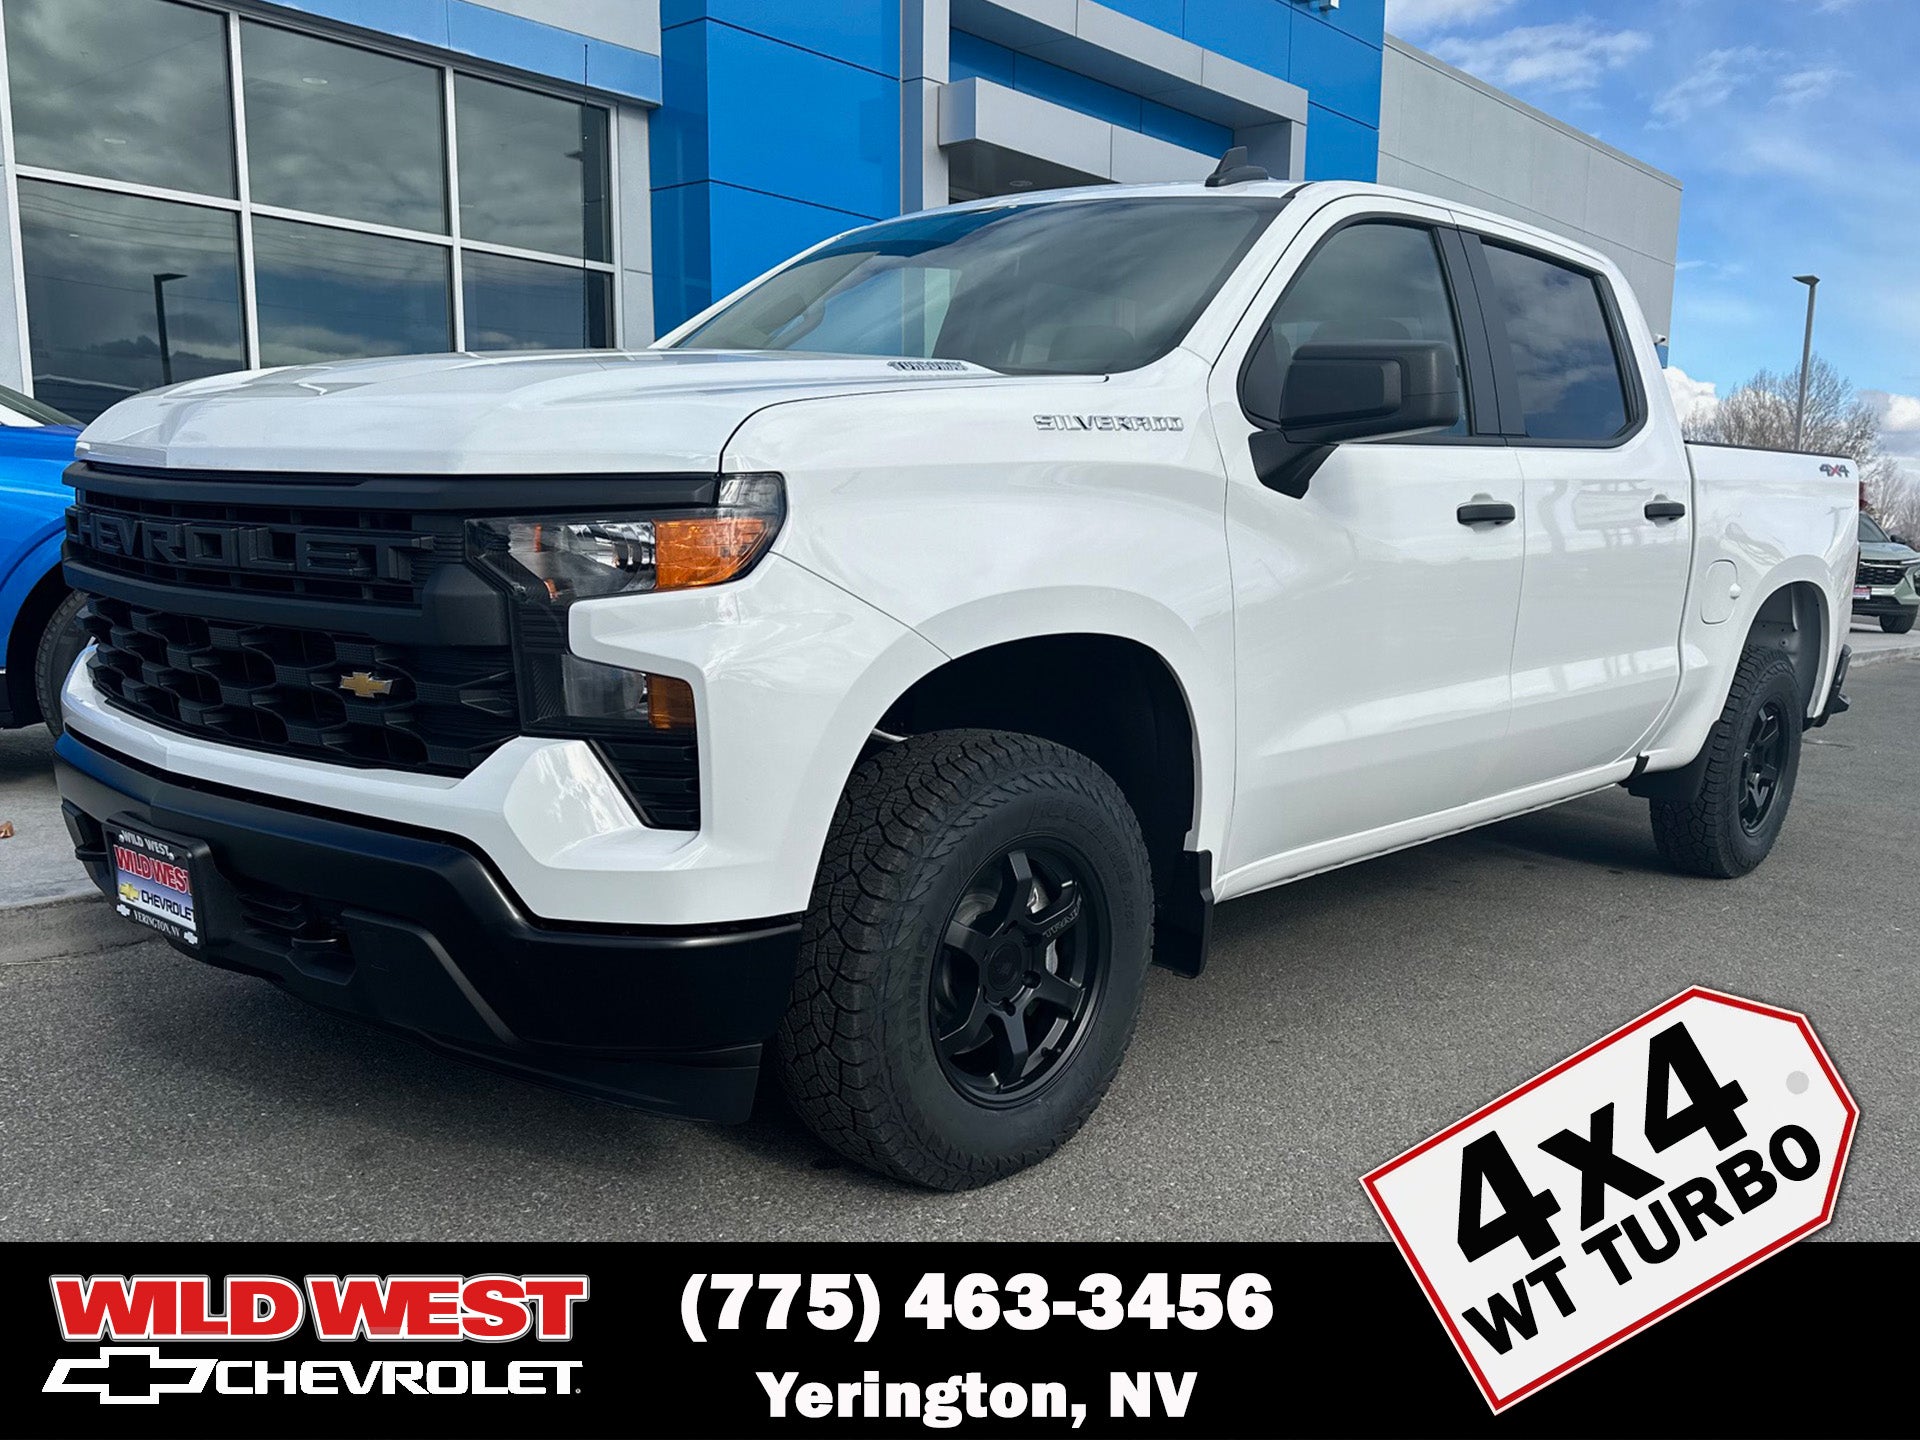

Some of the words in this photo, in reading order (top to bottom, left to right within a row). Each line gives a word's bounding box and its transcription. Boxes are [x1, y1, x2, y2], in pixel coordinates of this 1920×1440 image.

[1033, 414, 1184, 432] SILVERADO
[65, 505, 436, 581] CHEVROLET
[122, 830, 144, 847] WILD
[144, 838, 170, 856] WEST
[113, 844, 153, 880] WILD
